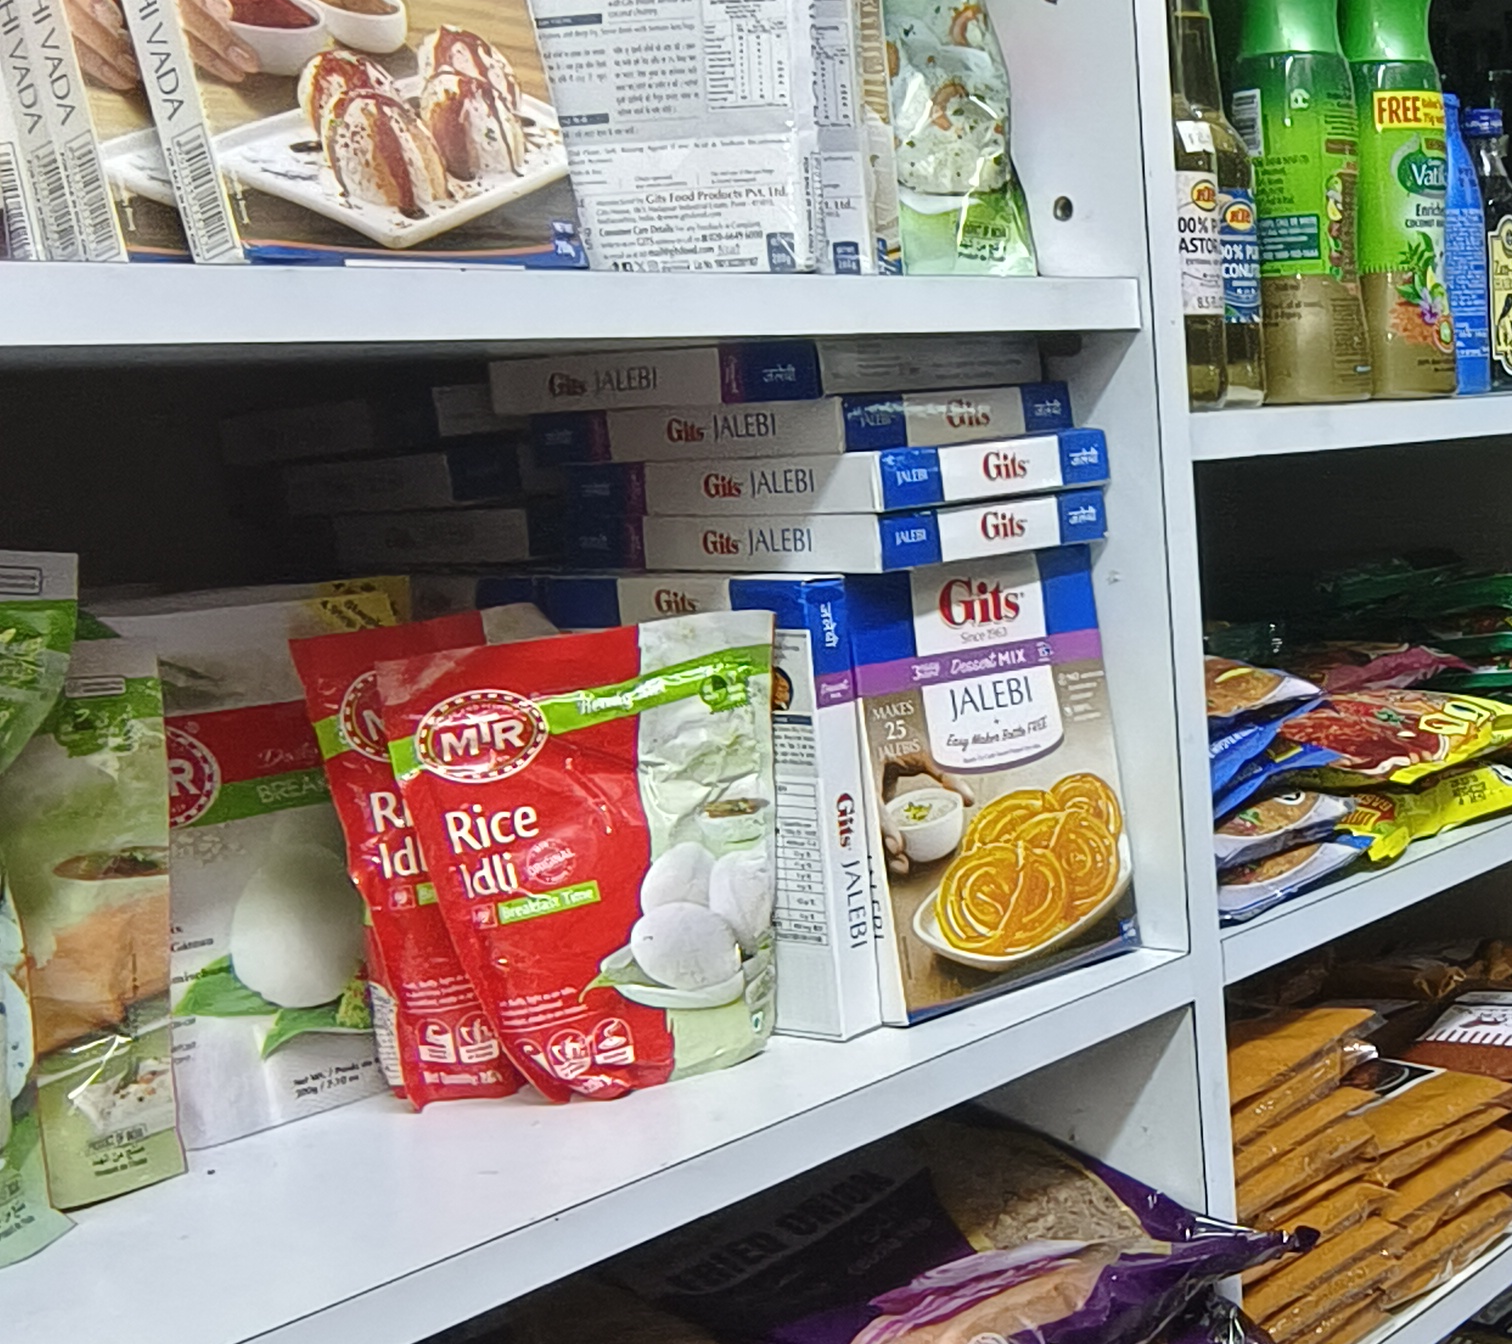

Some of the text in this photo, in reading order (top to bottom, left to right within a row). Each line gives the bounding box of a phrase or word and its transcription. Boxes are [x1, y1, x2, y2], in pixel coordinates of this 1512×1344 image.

[41, 28, 75, 127] VADA
[146, 23, 186, 122] VADA
[1377, 96, 1422, 125] FREE
[594, 366, 658, 395] JALEBI
[666, 412, 776, 443] Gits JALEBI
[896, 469, 929, 486] JALEBI
[982, 452, 1028, 481] Gits
[703, 468, 814, 498] Gits JALEBI
[895, 529, 927, 546] JALEBI
[981, 511, 1026, 540] Gits
[702, 528, 812, 556] Gits JALEBI
[654, 589, 696, 614] Gits
[939, 577, 1020, 627] Gits
[999, 649, 1025, 667] MIX
[872, 700, 915, 721] MAKES
[950, 676, 1033, 722] JALEBI
[438, 718, 524, 762] MTR
[884, 721, 907, 740] 25
[445, 805, 540, 854] Rice
[460, 853, 519, 900] Idli
[835, 792, 868, 950] Gits JALEBI
[562, 886, 595, 906] Time
